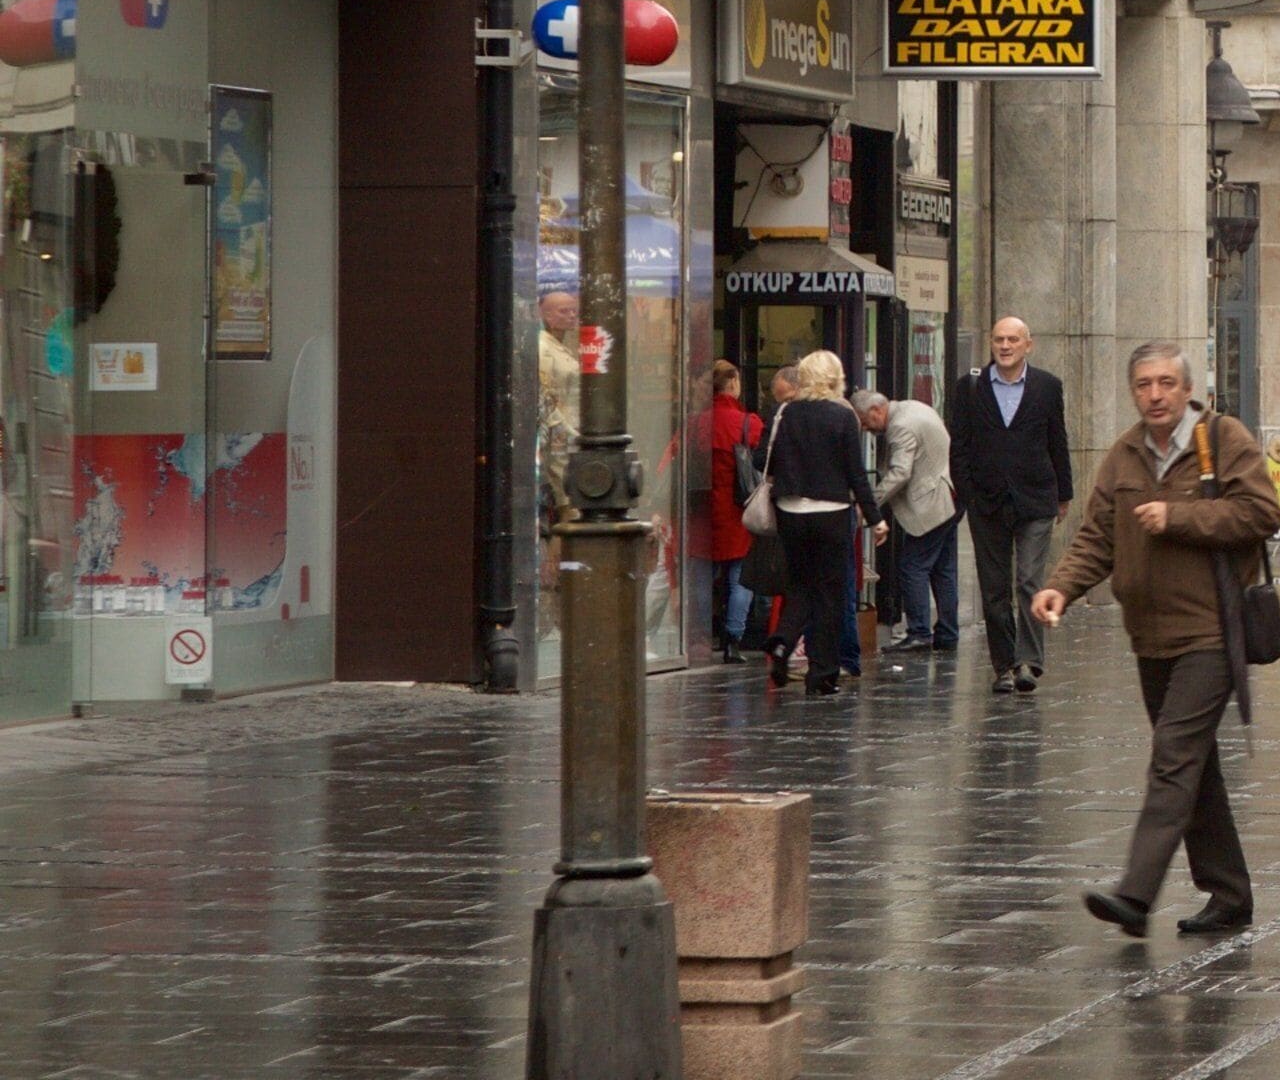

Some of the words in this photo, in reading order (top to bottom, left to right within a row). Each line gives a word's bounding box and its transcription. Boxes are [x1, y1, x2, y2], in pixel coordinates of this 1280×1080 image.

[909, 18, 1074, 38] DAVID
[896, 41, 1086, 65] FILIGRAN
[901, 190, 951, 224] BEOGRAD
[726, 272, 794, 293] OTKUP
[798, 272, 862, 293] ZLATA
